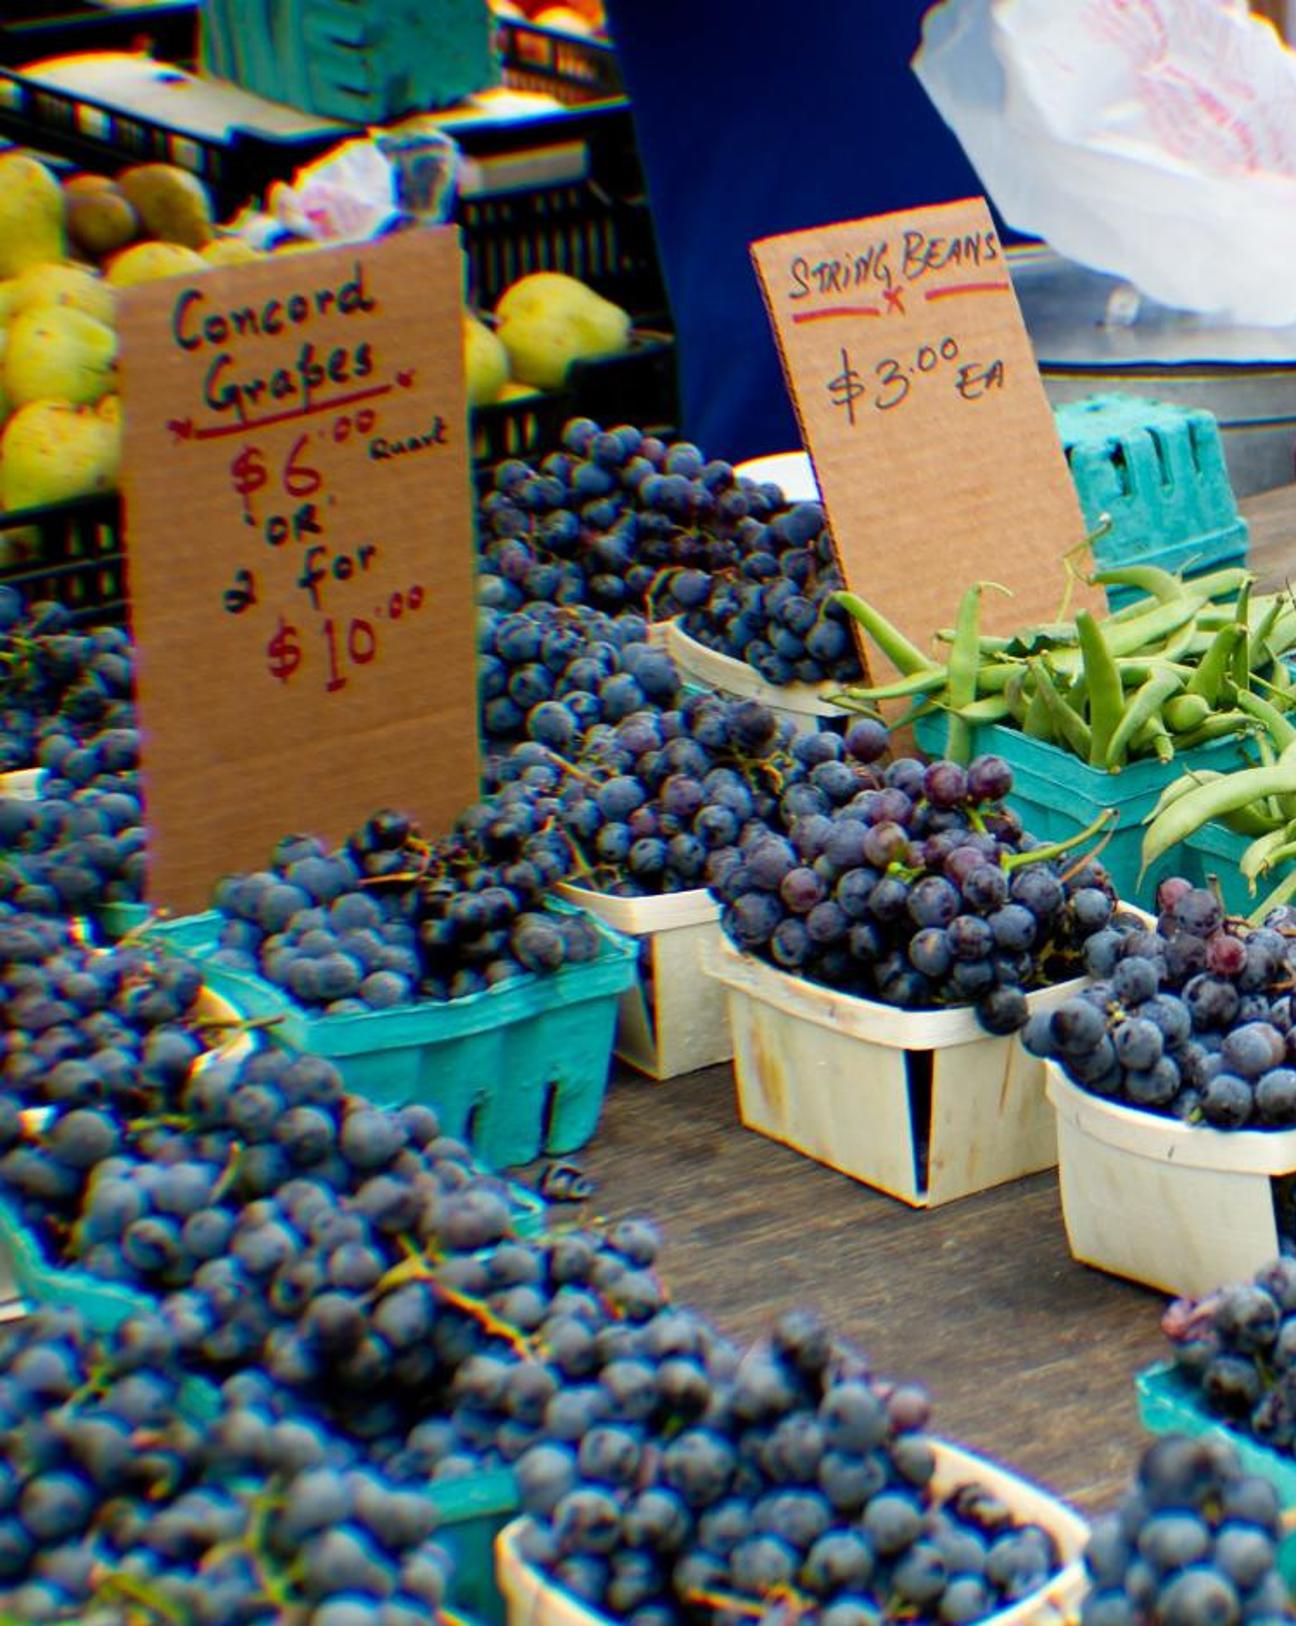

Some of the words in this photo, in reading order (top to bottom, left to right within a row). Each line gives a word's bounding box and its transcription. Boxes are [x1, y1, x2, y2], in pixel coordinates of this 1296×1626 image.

[901, 230, 999, 280] BEANS
[172, 259, 377, 350] Concord
[204, 342, 375, 424] Grapes
[827, 336, 959, 427] $3.00
[955, 359, 1005, 400] EA
[222, 568, 258, 614] 2
[296, 544, 378, 612] for
